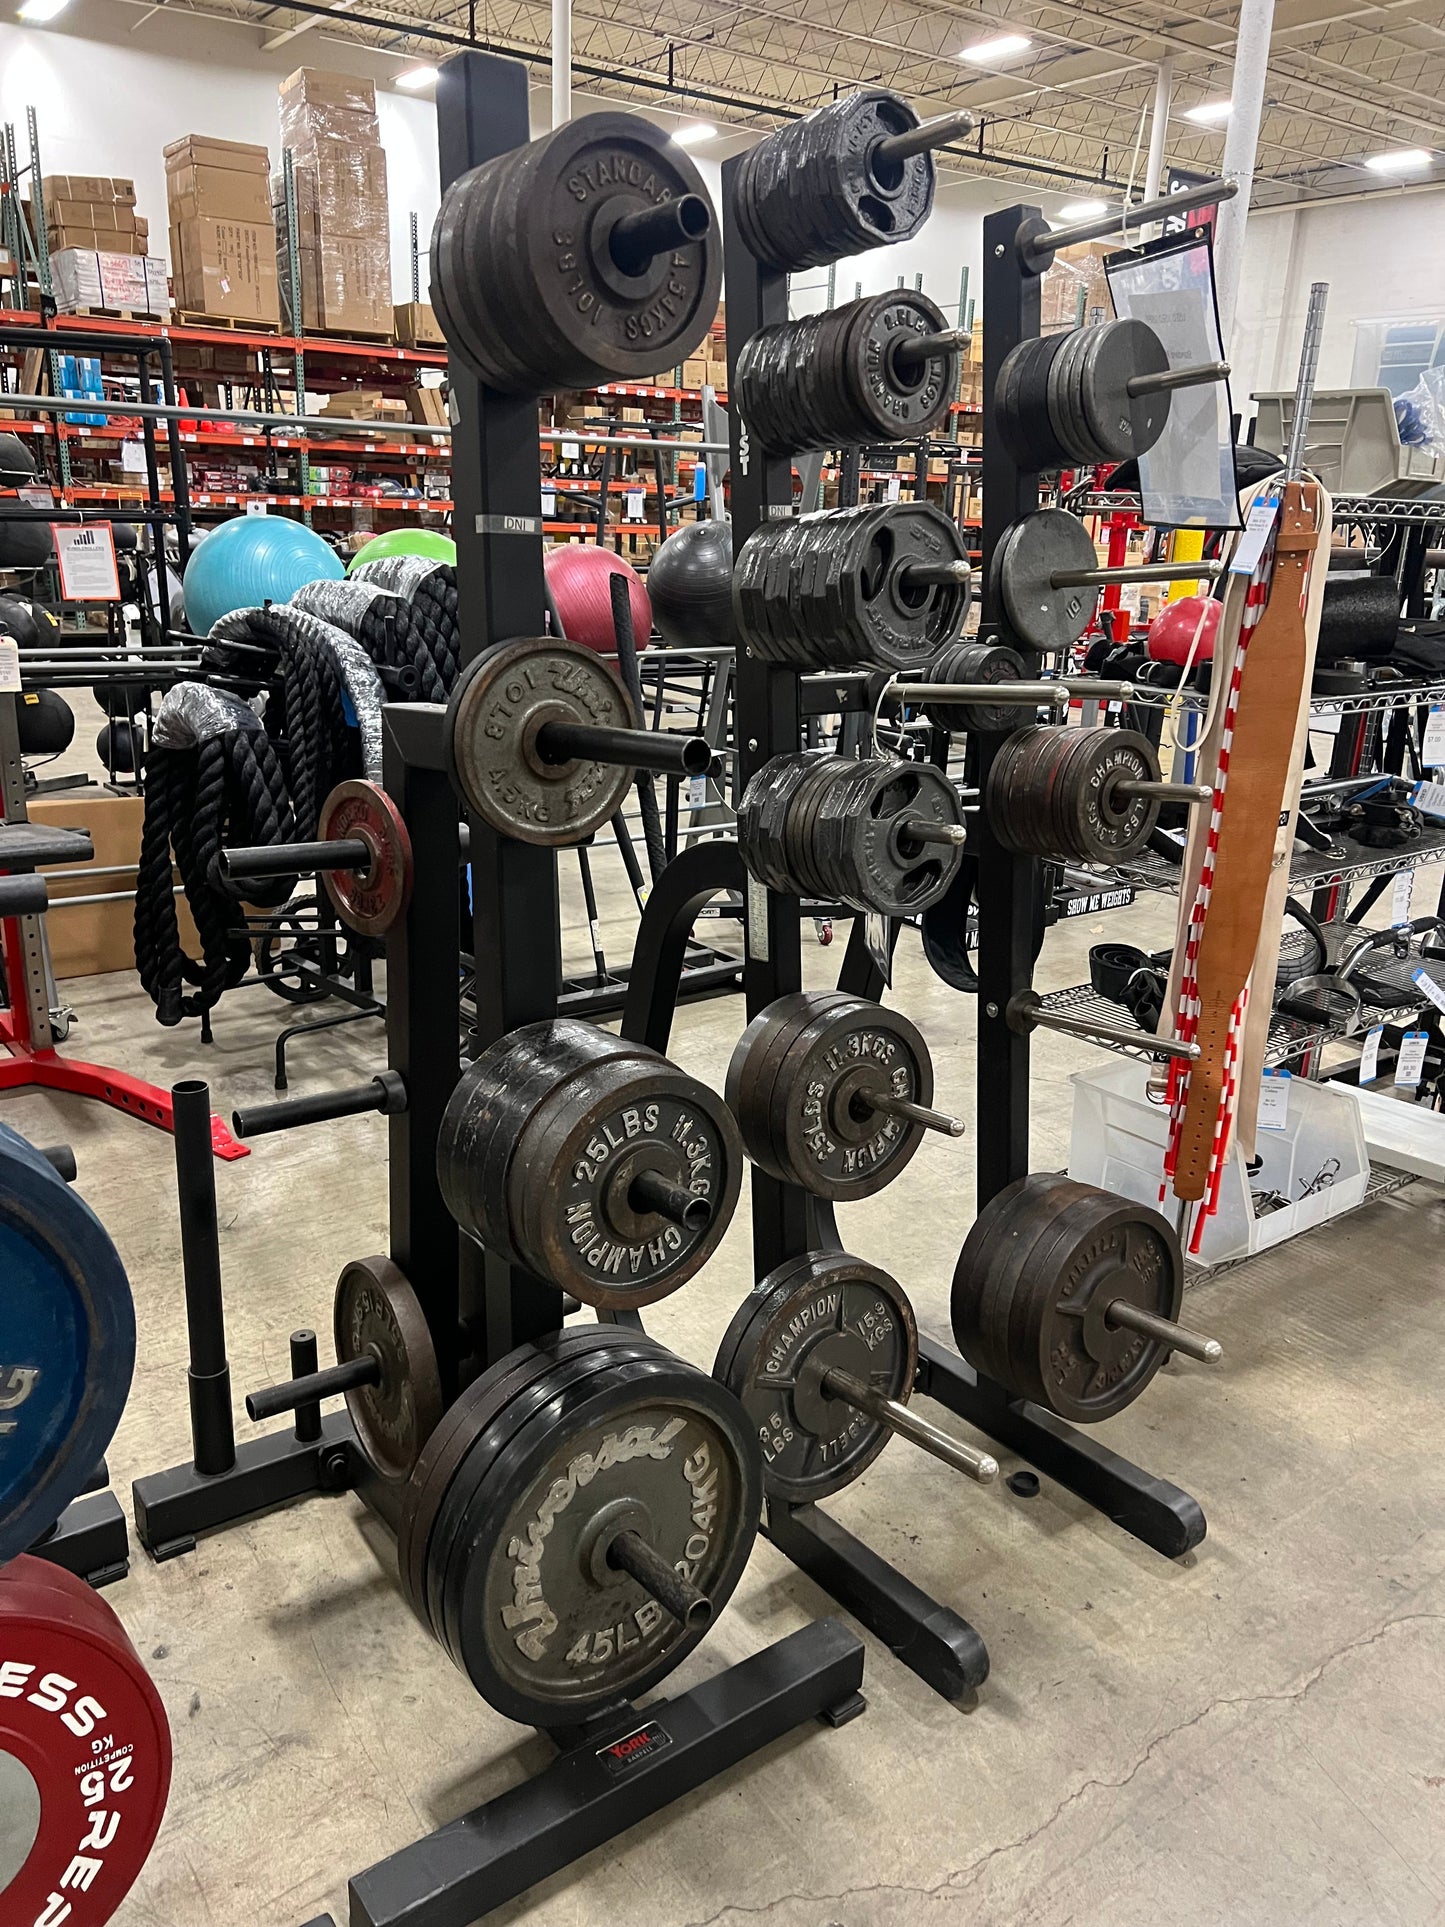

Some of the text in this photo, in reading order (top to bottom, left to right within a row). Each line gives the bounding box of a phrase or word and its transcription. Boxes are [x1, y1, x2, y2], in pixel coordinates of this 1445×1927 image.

[567, 155, 672, 204] STANDAR
[506, 517, 526, 531] DNI
[770, 506, 786, 516] DNI
[1090, 750, 1145, 788] CHAMPION
[1123, 798, 1144, 837] LBS
[1067, 888, 1132, 916] SHOW ME WEIGHTS
[823, 1032, 896, 1072] 11.3KGS
[803, 1080, 837, 1164] 25LBS
[841, 1065, 910, 1174] CHMPION
[573, 1103, 660, 1184] 25LBS
[566, 1200, 683, 1275] CHAMPION
[765, 1294, 837, 1373] CHAMPION
[855, 1301, 887, 1337] 15.9
[864, 1317, 894, 1352] KGS
[758, 1411, 783, 1443] 35
[763, 1426, 794, 1464] LBS
[819, 1410, 869, 1462] RBELL
[673, 1441, 719, 1585] 20.4KG
[500, 1415, 688, 1662] Universal
[565, 1600, 664, 1670] 45LB
[74, 1743, 135, 1776] COMPETITION
[91, 1733, 114, 1755] KG
[608, 1731, 652, 1760] YORK
[79, 1755, 135, 1808] 25
[32, 1810, 122, 1927] REP
